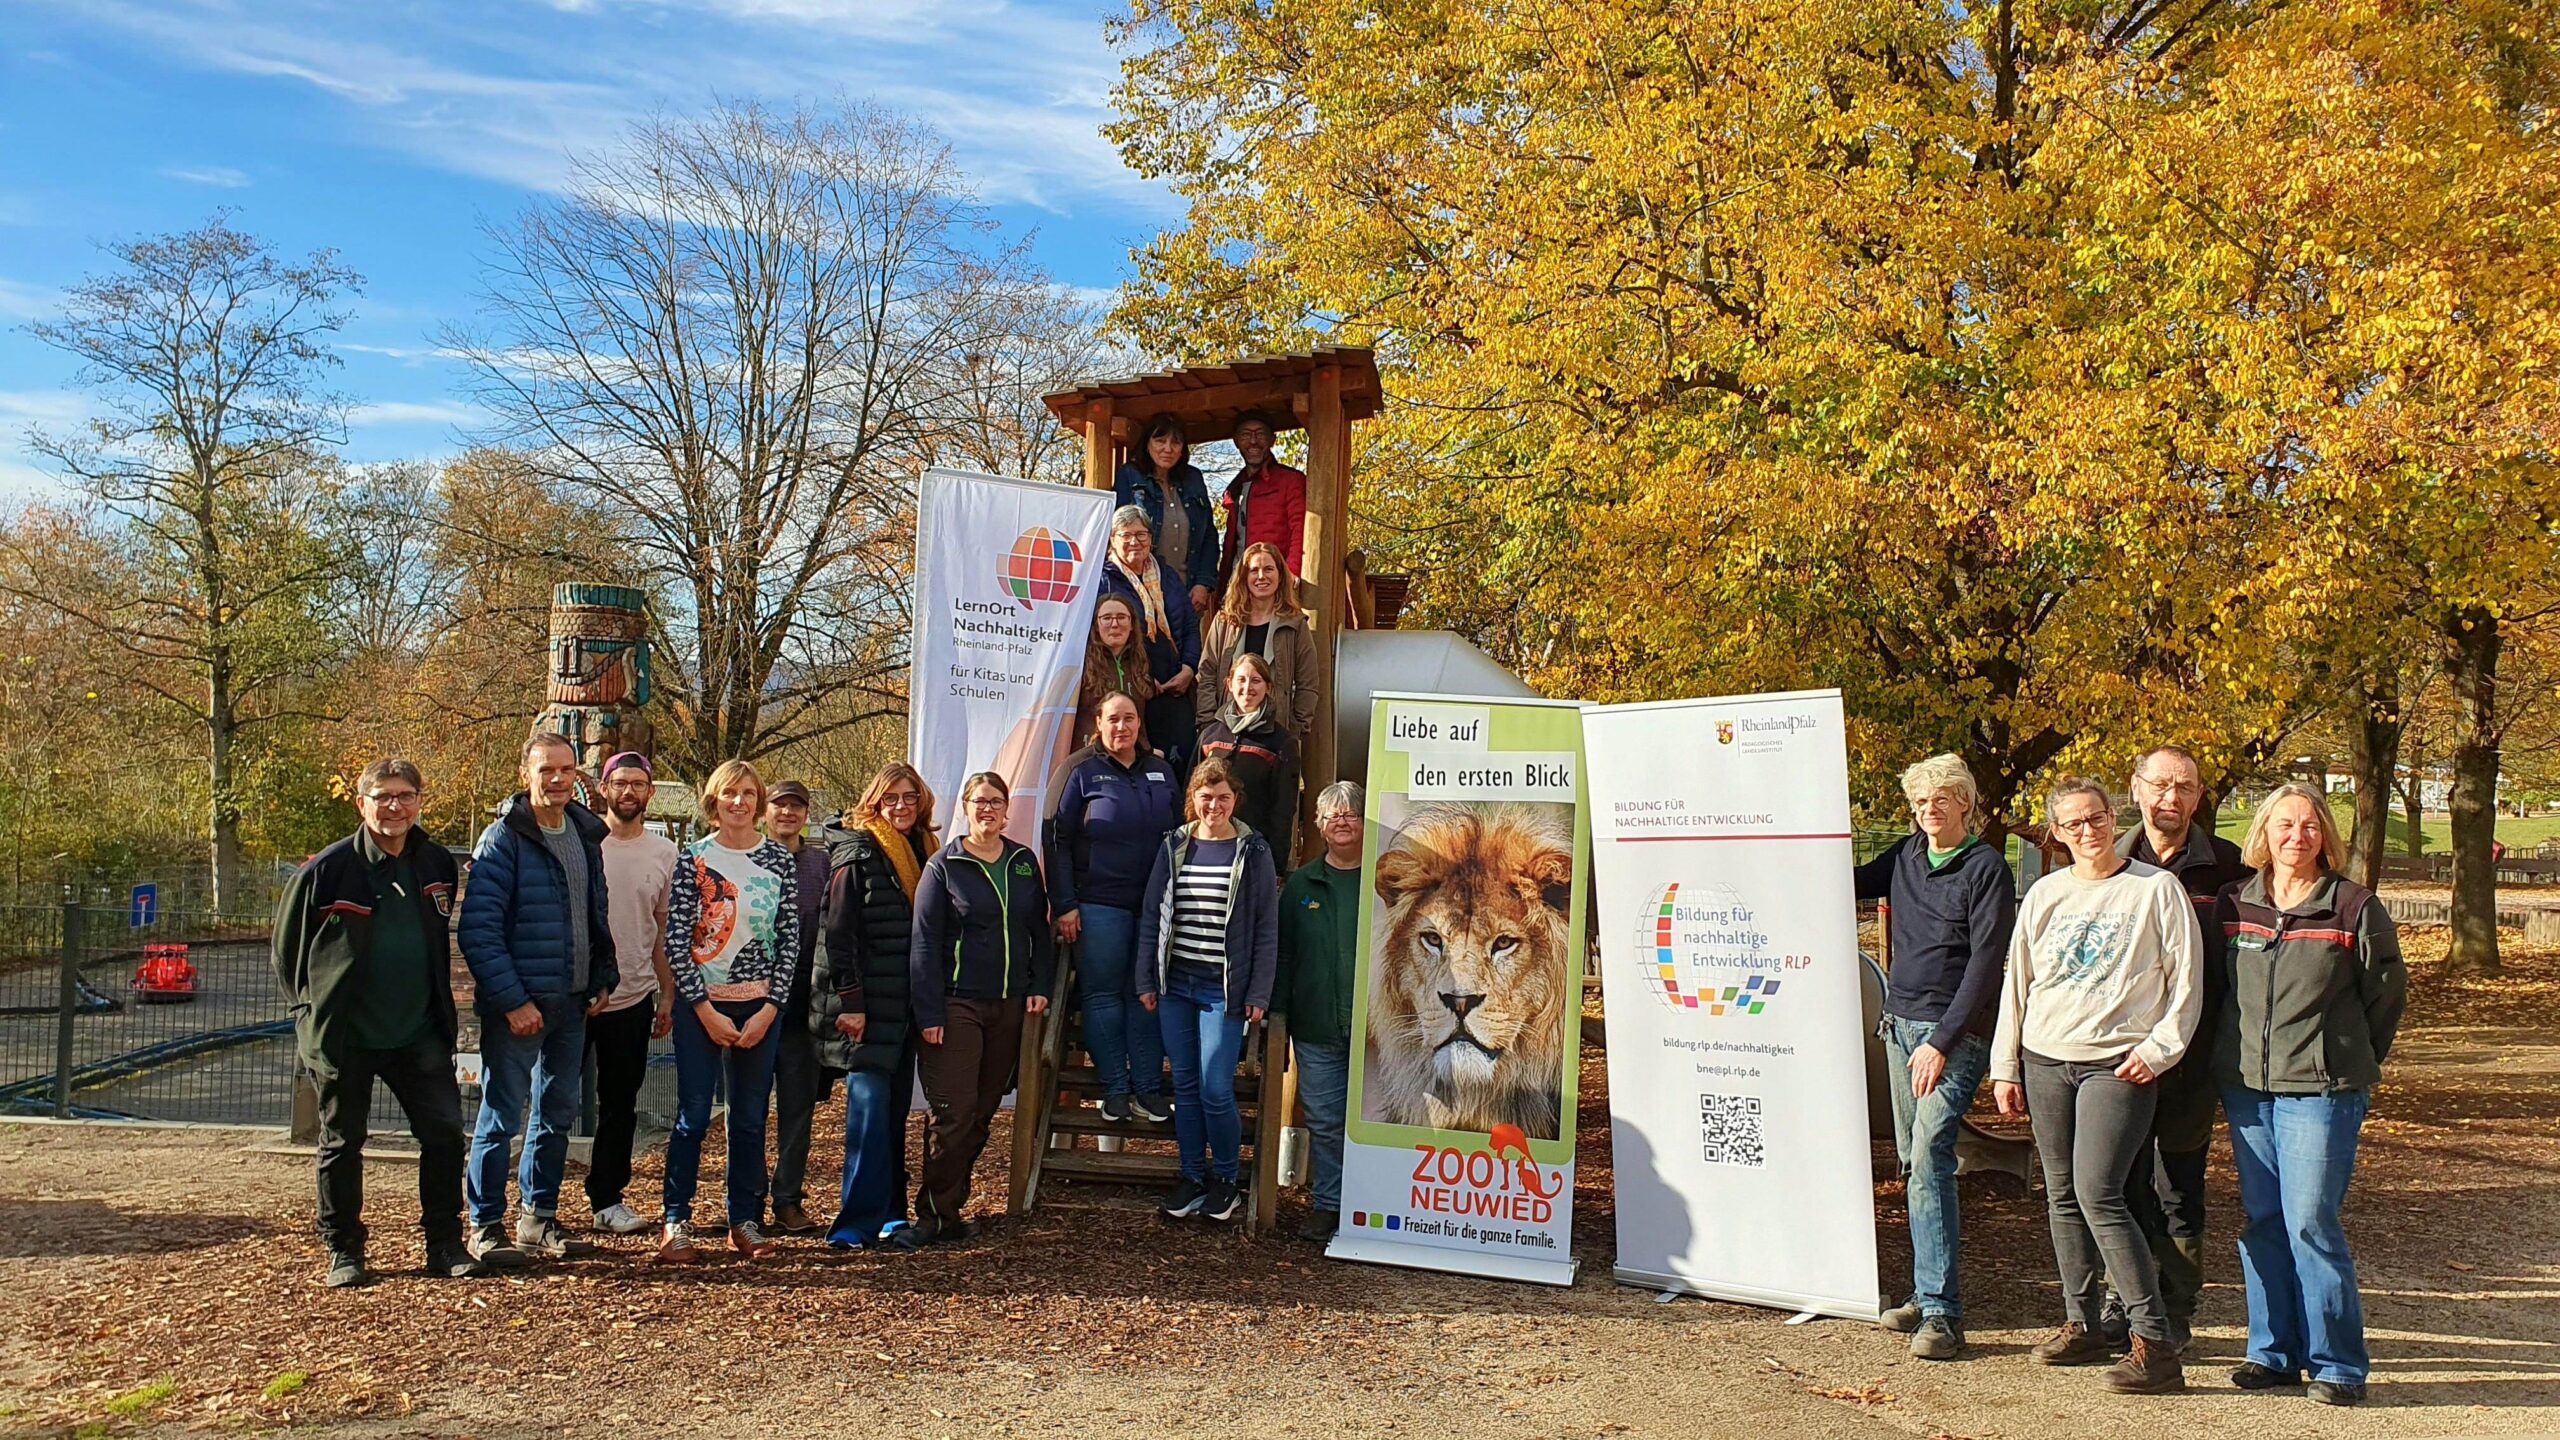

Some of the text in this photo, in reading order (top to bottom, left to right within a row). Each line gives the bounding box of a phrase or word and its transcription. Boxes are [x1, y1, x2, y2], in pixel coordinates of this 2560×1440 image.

[955, 598, 1016, 617] LernOrt
[954, 617, 1063, 642] Nachhaltigkeit
[952, 637, 1033, 655] Rheinland-Pfalz
[950, 664, 1034, 686] für Kitas und
[949, 684, 1005, 701] Schulen
[1392, 715, 1480, 742] Liebe auf
[1414, 763, 1570, 788] den ersten Blick
[1614, 798, 1685, 812] BILDUNG FÜR
[1615, 813, 1774, 828] NACHHALTIGE ENTWICKLUNG
[1675, 907, 1754, 925] Bildung für
[1683, 931, 1768, 948] nachhaltige
[1692, 954, 1811, 972] Entwicklung RLP
[1663, 1037, 1795, 1057] bildung.rlp.de/nachhaltigkeit
[1696, 1063, 1761, 1078] bne@pl.rlp.de
[1412, 1144, 1494, 1189] ZOO
[1411, 1185, 1552, 1223] NEUWIED
[1404, 1216, 1556, 1249] Freizeit für die ganze Familie.
